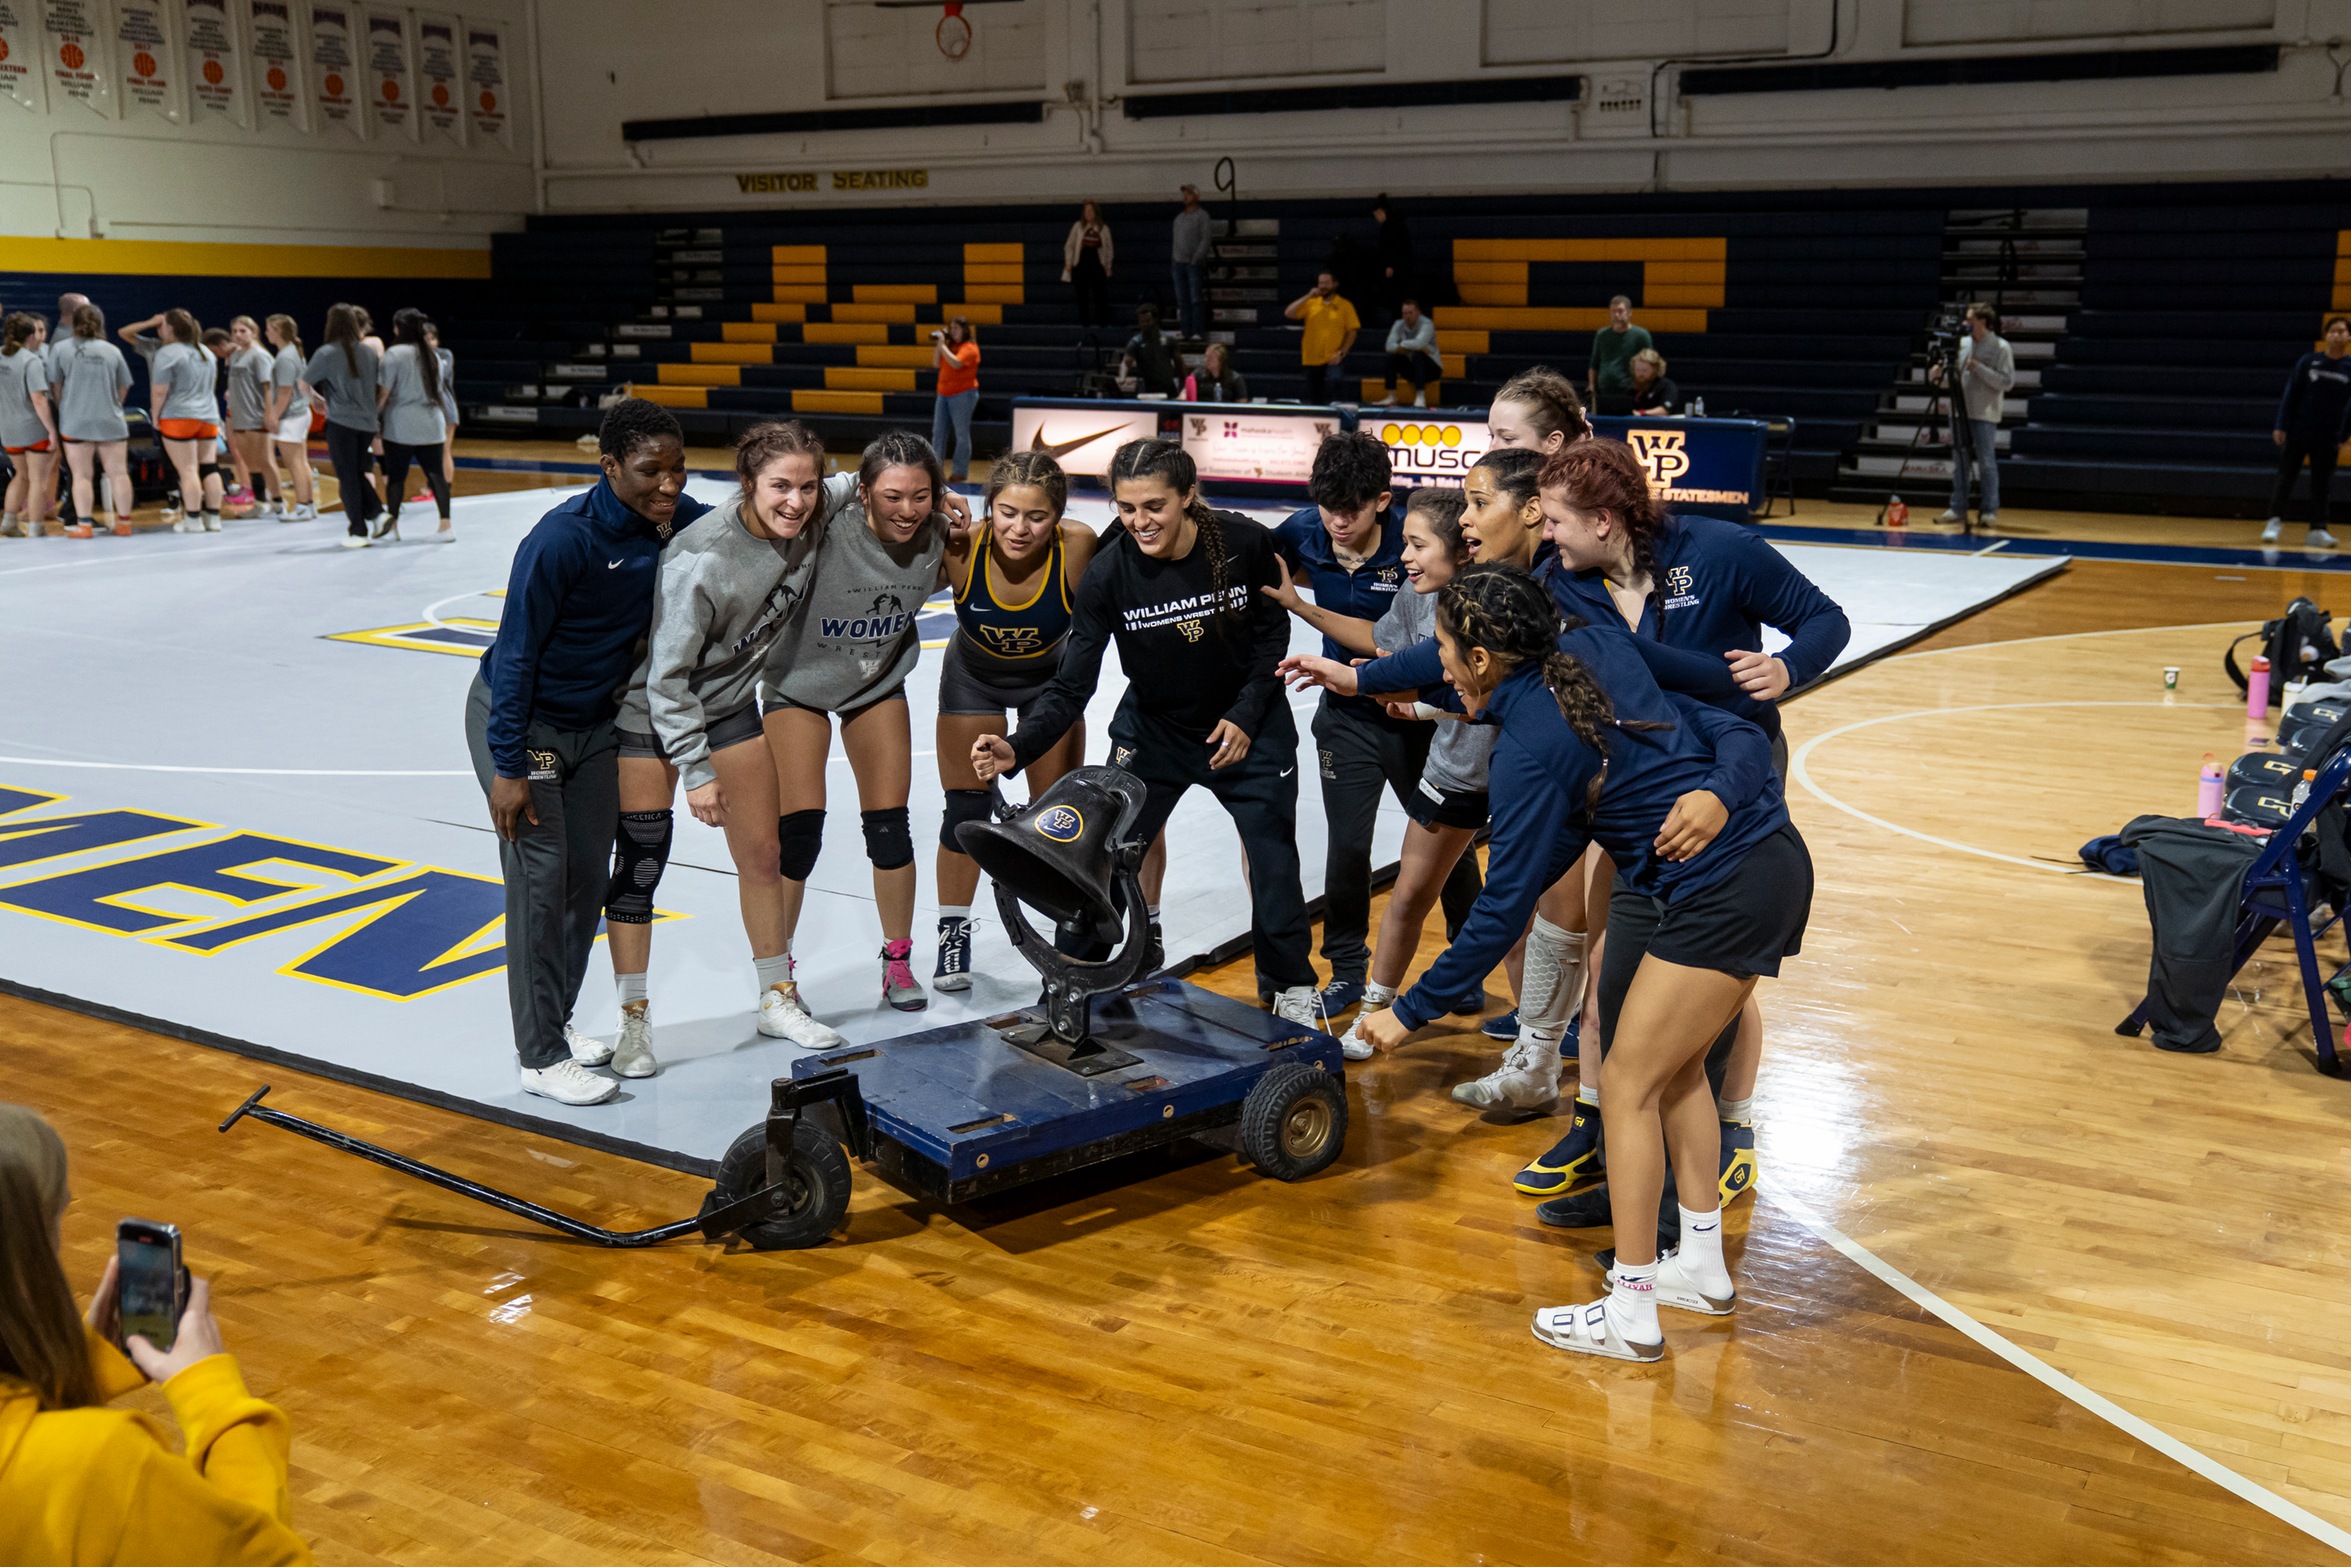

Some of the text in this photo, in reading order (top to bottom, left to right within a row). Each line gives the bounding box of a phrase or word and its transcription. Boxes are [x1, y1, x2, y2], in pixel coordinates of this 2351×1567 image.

[736, 168, 929, 194] VISITOR SEATING
[1390, 447, 1481, 469] musc
[1627, 429, 1690, 489] WP
[1662, 488, 1749, 504] STATESMEN
[852, 584, 897, 593] WILLIAM
[1123, 596, 1198, 621] WILLIAM
[1141, 615, 1183, 629] WOMENS
[1177, 619, 1204, 643] WP
[979, 623, 1043, 654] WP
